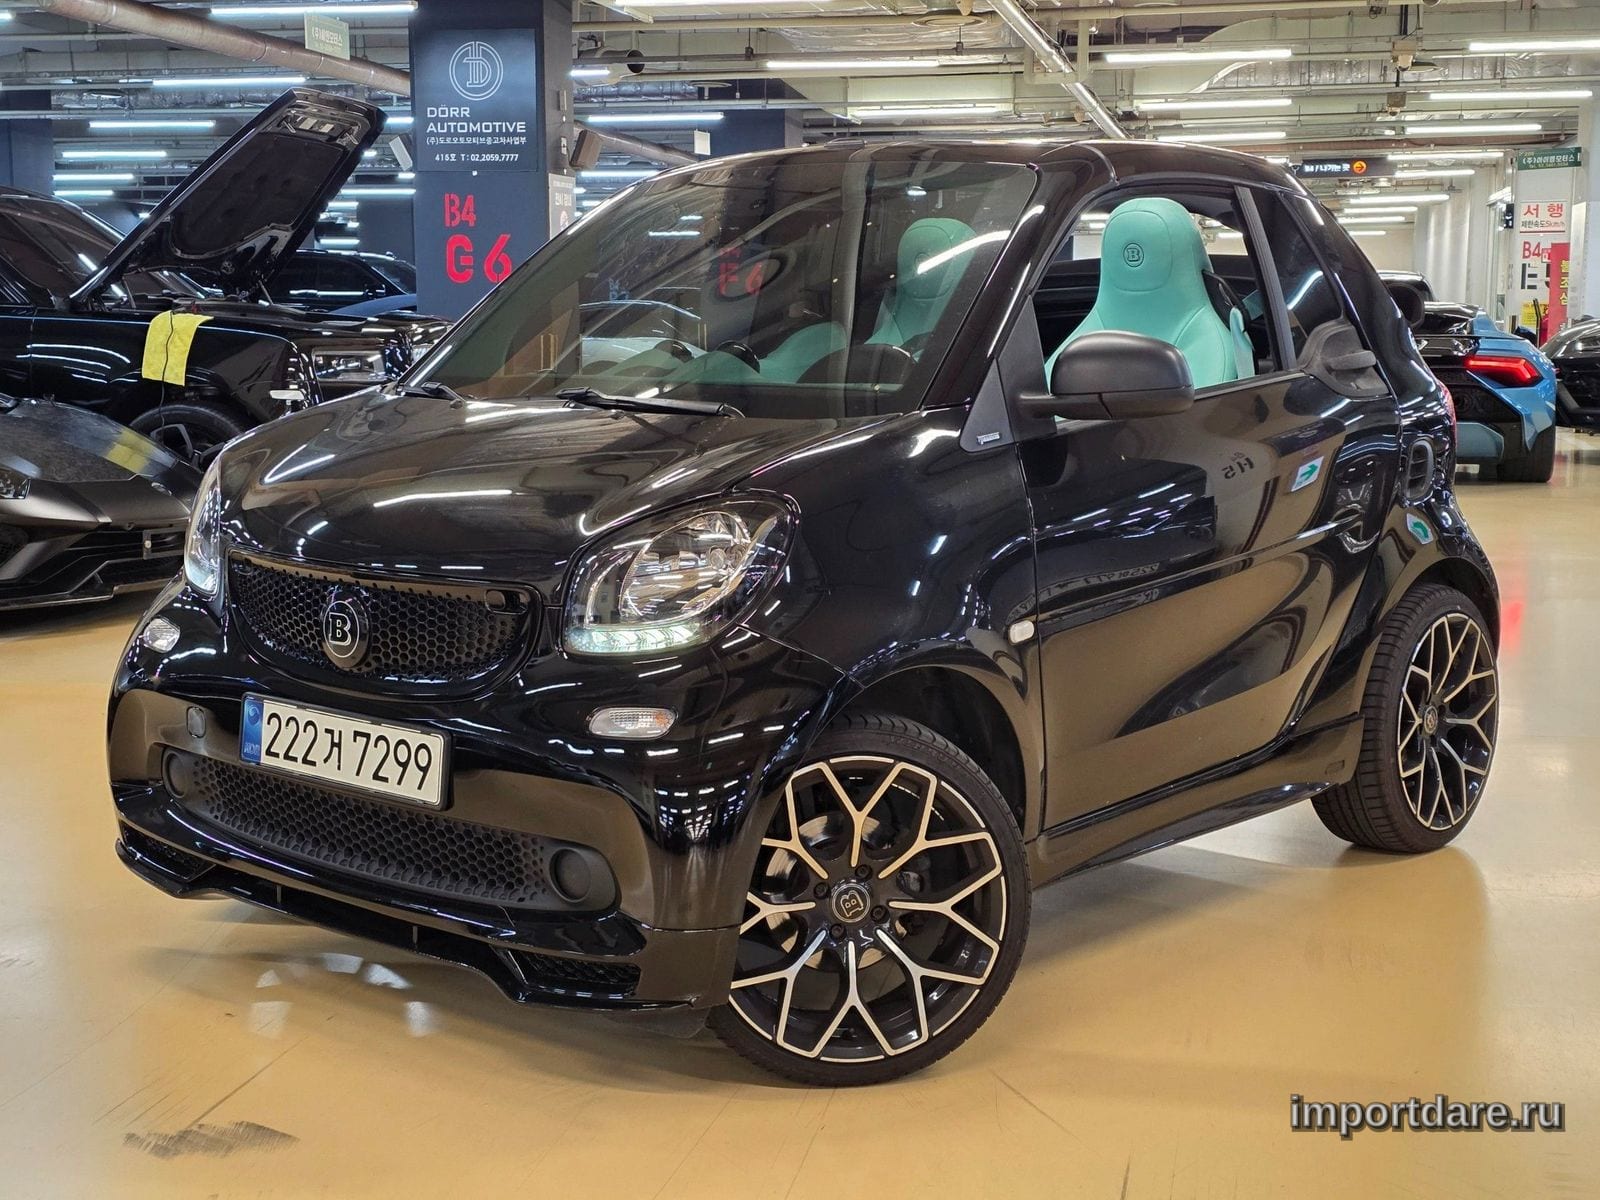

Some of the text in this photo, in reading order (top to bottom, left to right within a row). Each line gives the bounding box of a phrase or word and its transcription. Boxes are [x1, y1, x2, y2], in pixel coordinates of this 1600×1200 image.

[427, 104, 470, 118] DÖRR
[426, 122, 526, 133] AUTOMOTIVE
[444, 193, 477, 227] B4
[1522, 241, 1541, 259] B4
